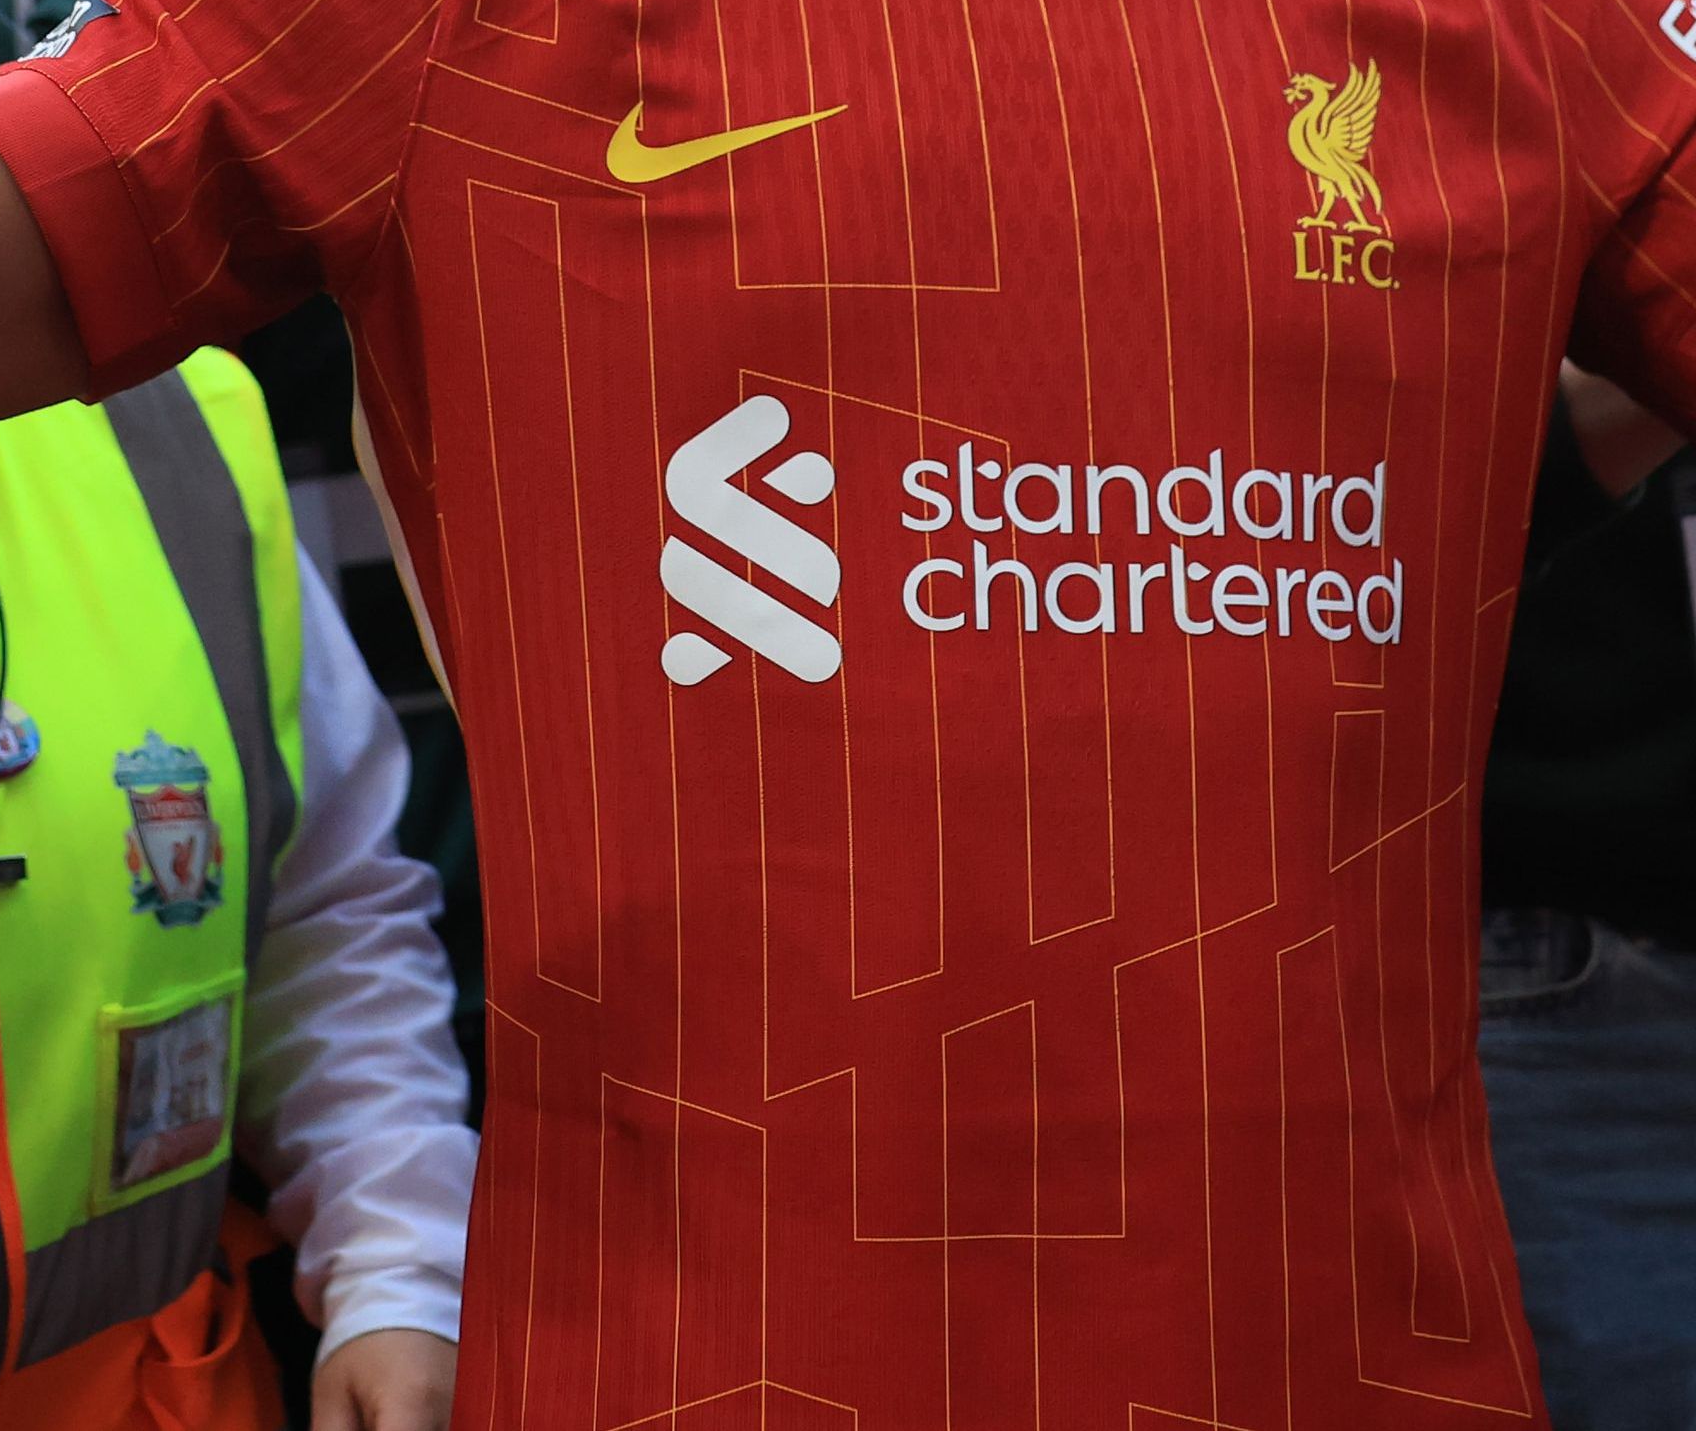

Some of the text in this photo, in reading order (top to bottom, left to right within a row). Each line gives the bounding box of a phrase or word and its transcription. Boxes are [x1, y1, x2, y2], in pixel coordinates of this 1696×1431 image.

[1293, 231, 1401, 290] L.F.C.
[901, 440, 1386, 548] standard
[902, 541, 1403, 645] chartered
